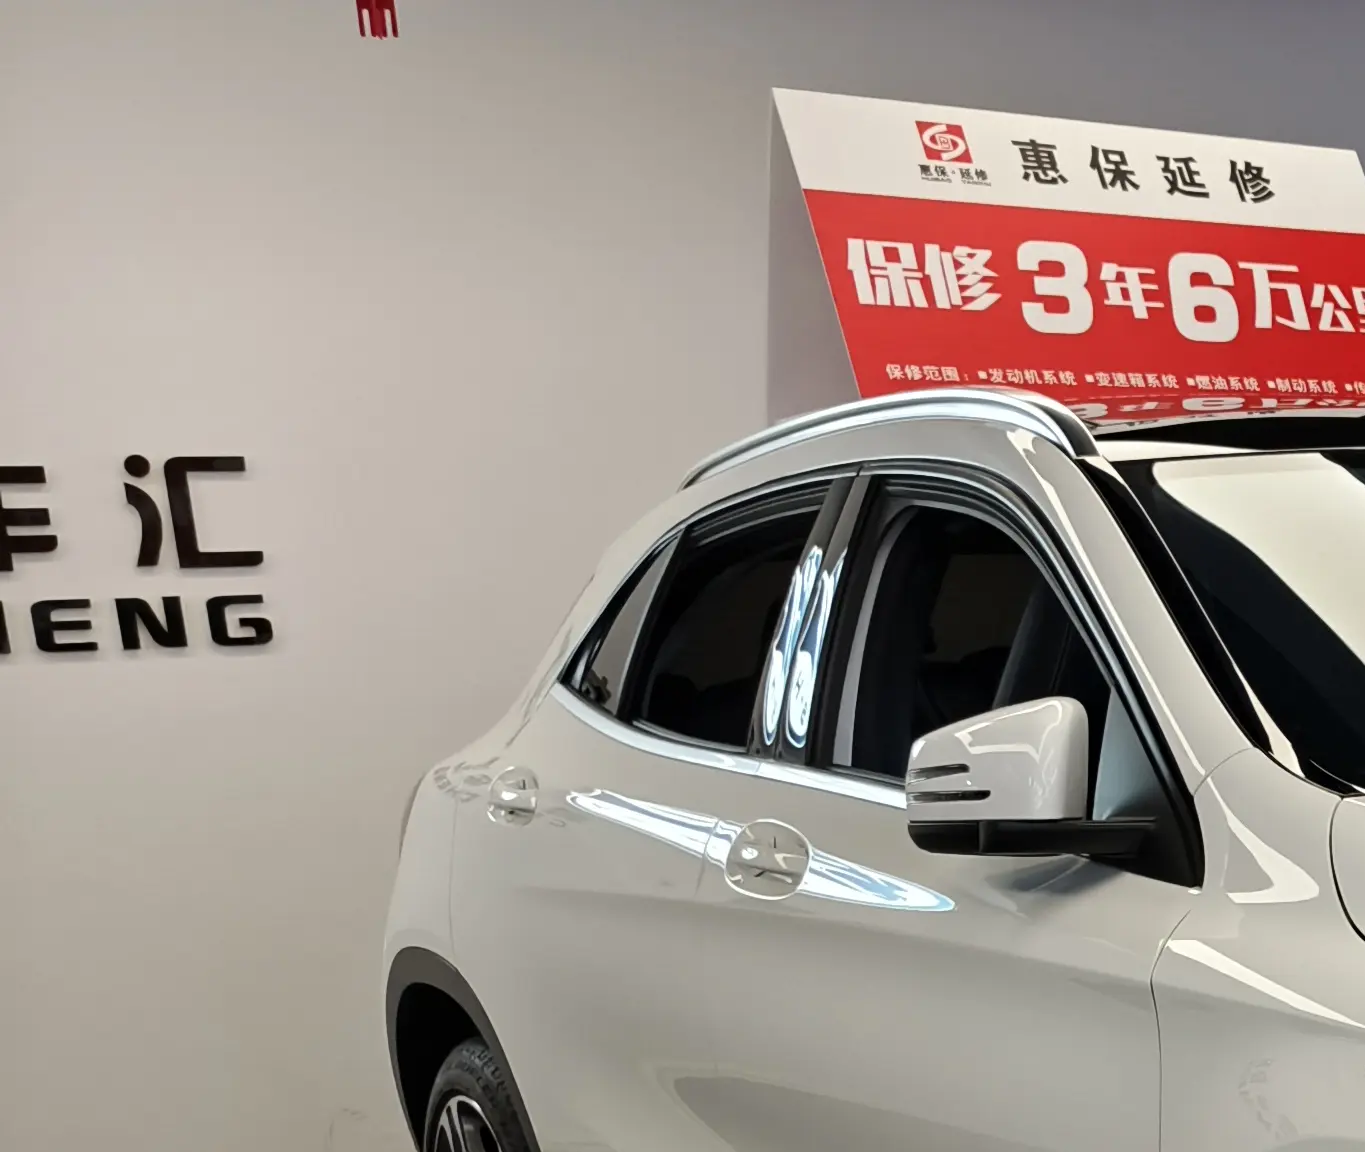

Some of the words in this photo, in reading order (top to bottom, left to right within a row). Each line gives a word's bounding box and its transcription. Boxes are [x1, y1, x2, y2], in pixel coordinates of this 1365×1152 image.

[1011, 139, 1276, 204] 惠保延修
[988, 368, 1078, 387] 发动机系统
[1275, 377, 1339, 394] 制动系统
